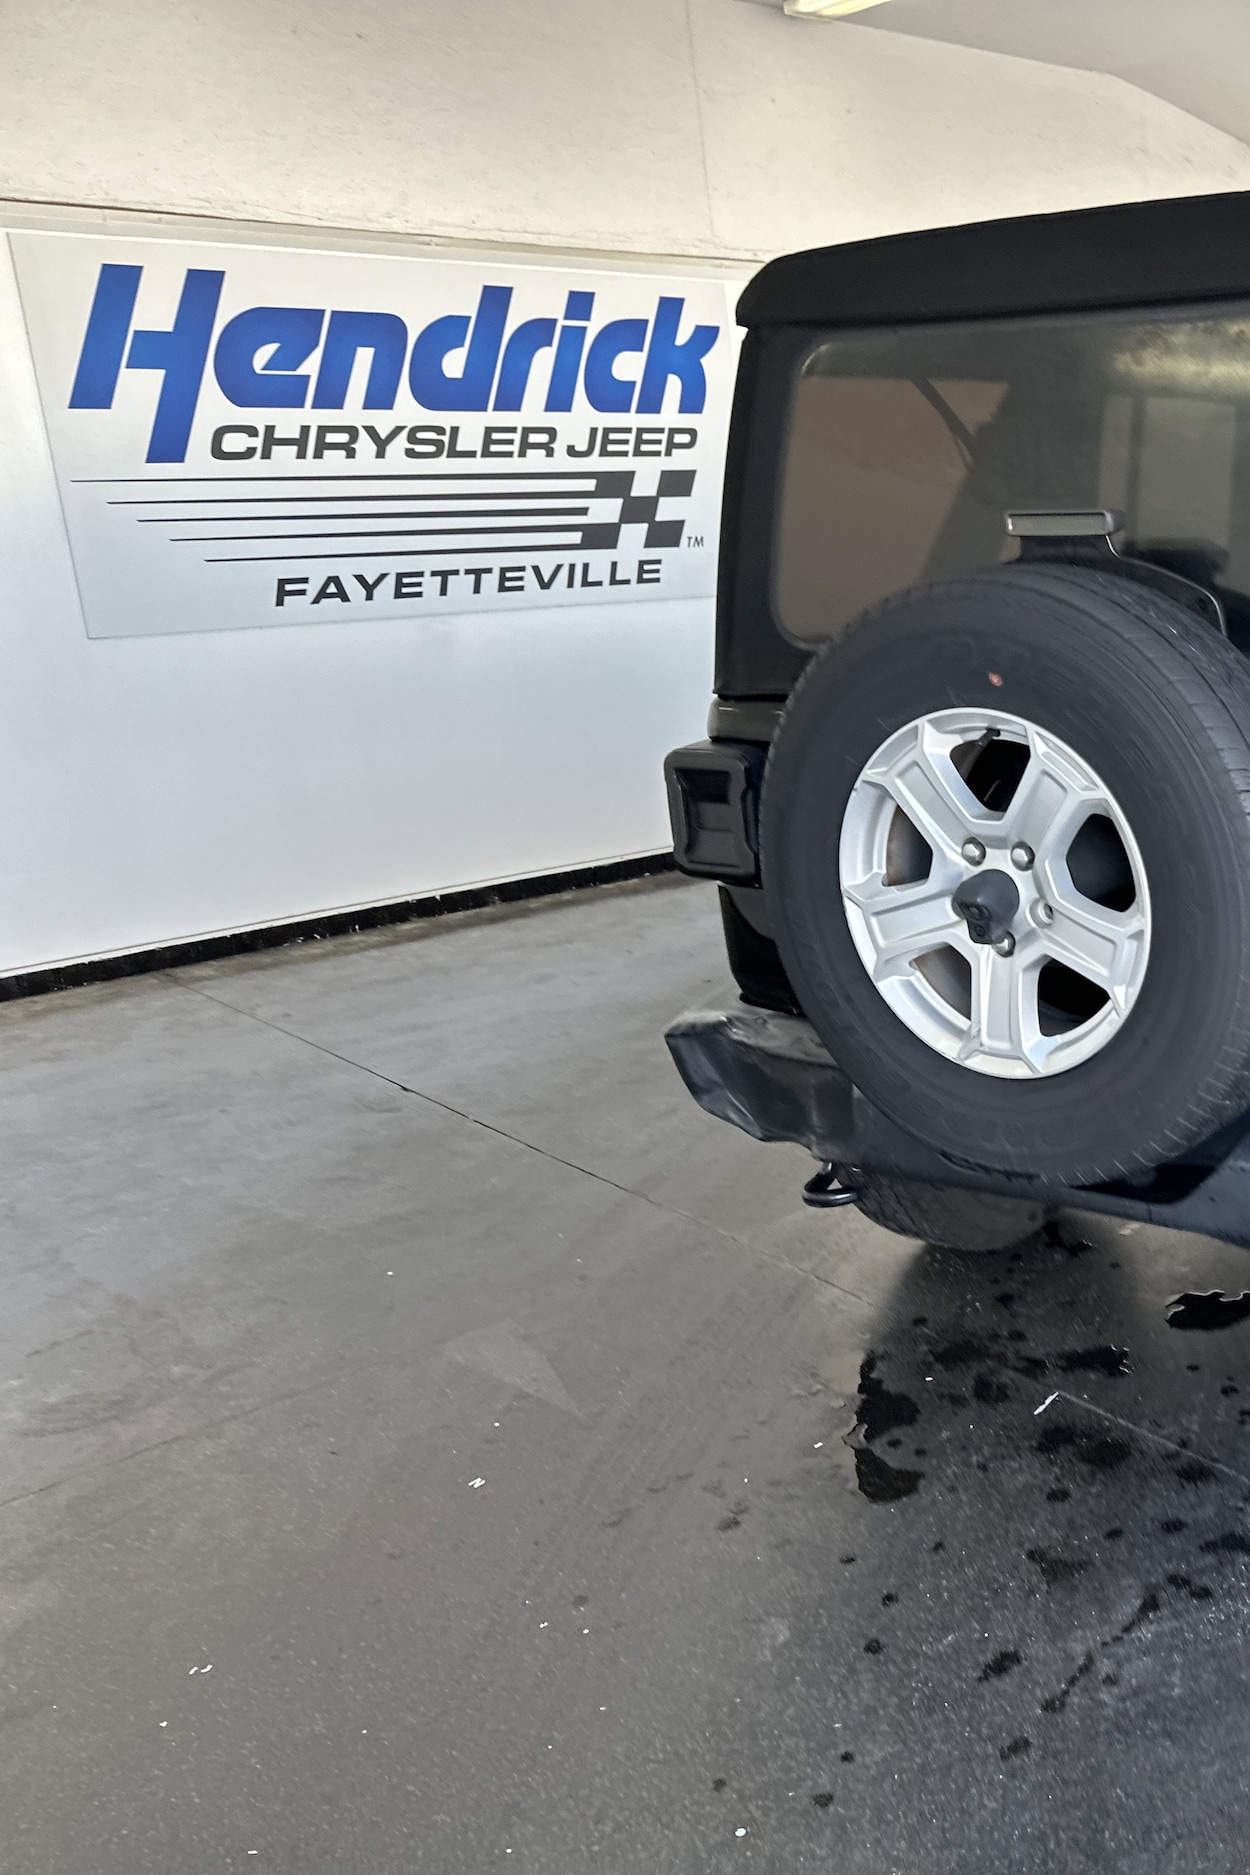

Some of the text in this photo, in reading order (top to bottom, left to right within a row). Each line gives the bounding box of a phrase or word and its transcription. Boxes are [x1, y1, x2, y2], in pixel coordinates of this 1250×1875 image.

[68, 263, 719, 463] Hendrick
[211, 425, 697, 460] CHRYSLER JEEP
[274, 558, 662, 607] FAYETTEVILLE
